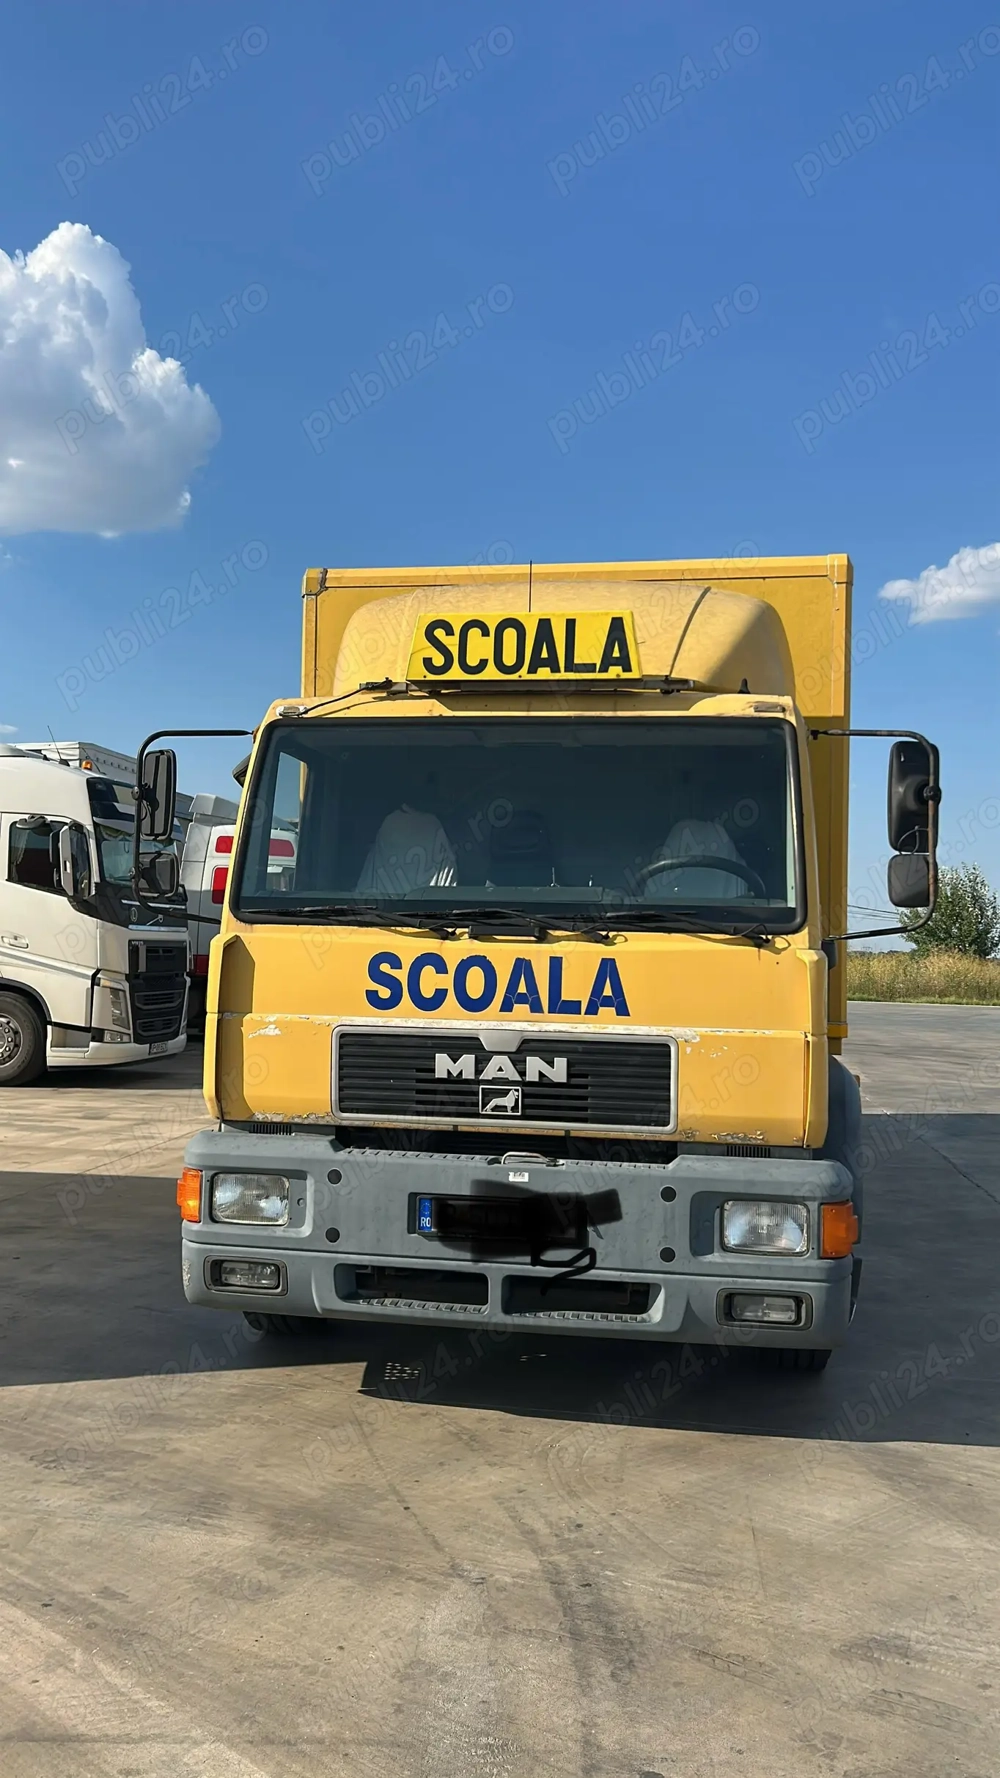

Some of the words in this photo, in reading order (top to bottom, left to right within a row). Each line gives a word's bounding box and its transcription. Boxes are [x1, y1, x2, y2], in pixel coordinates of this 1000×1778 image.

[423, 617, 633, 675] SCOALA
[365, 951, 631, 1017] SCOALA
[435, 1053, 568, 1083] MAN
[420, 1216, 432, 1228] RO
